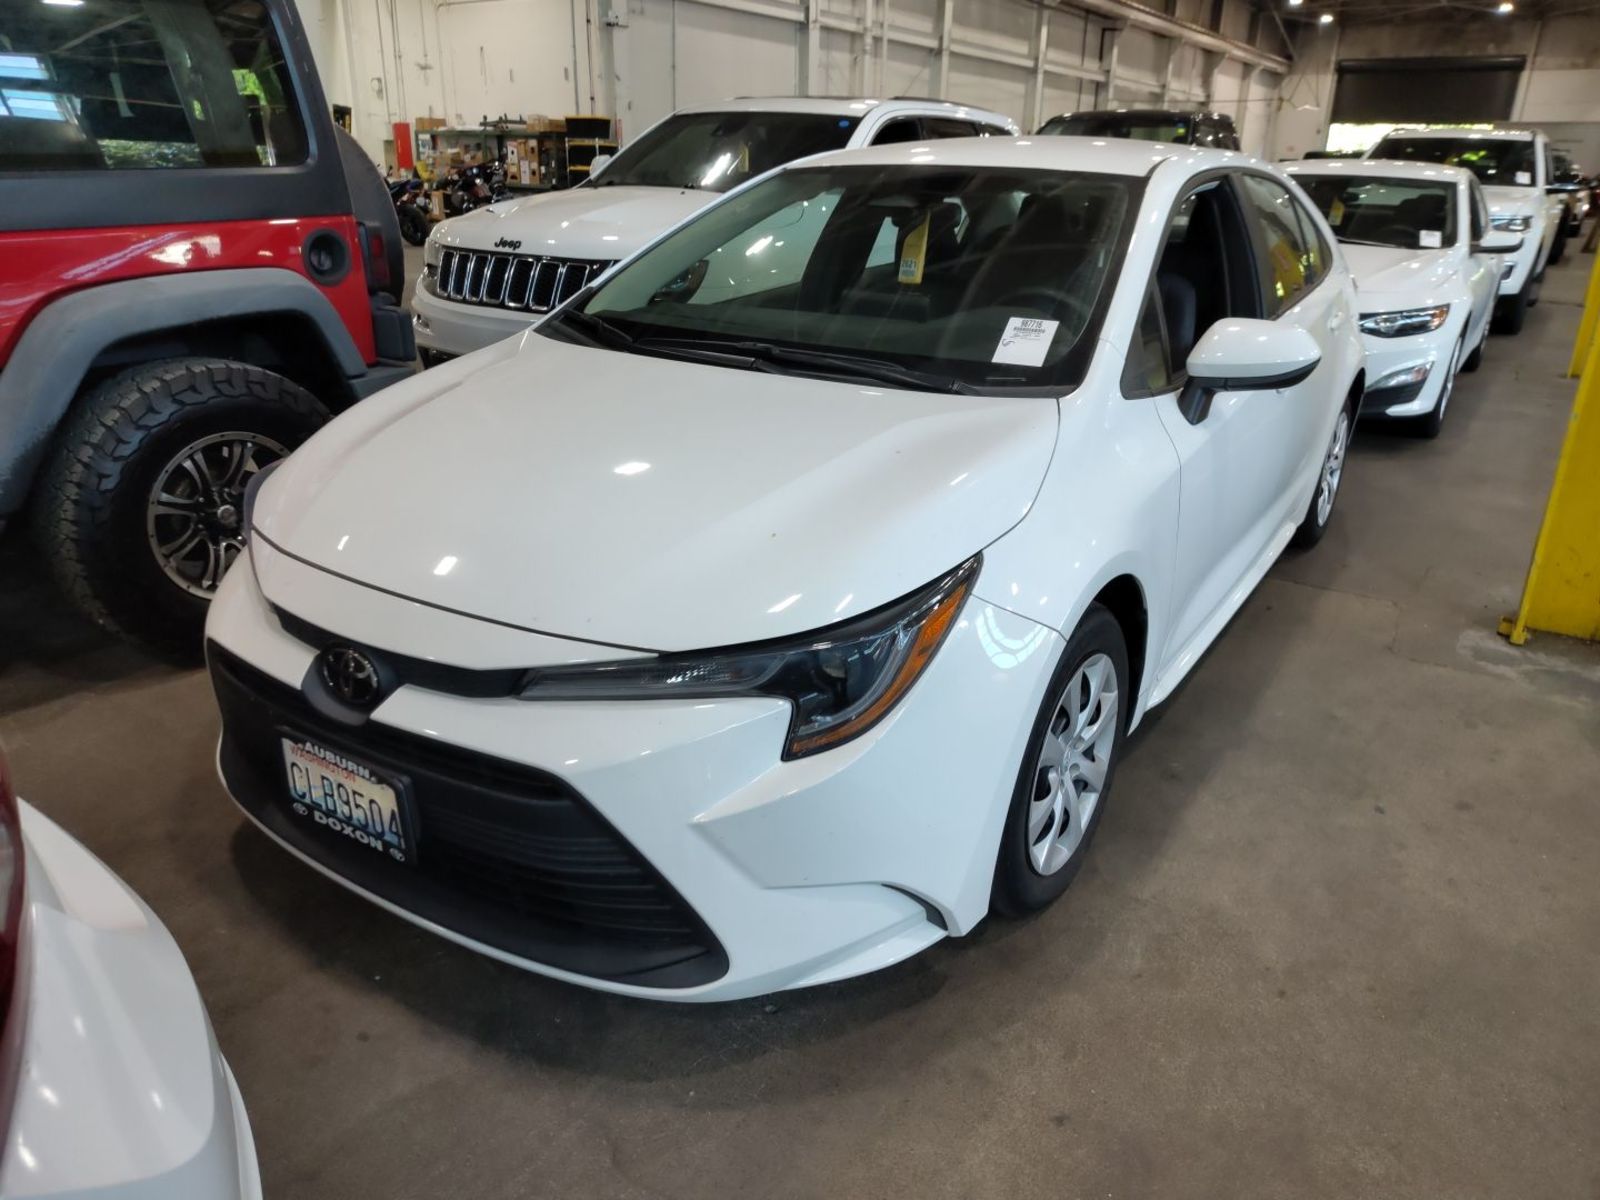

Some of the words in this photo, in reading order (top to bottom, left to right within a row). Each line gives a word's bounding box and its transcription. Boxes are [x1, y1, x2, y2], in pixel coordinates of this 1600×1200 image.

[494, 236, 522, 251] Jeep
[304, 741, 370, 779] AUBURN
[314, 809, 383, 852] DOXON
